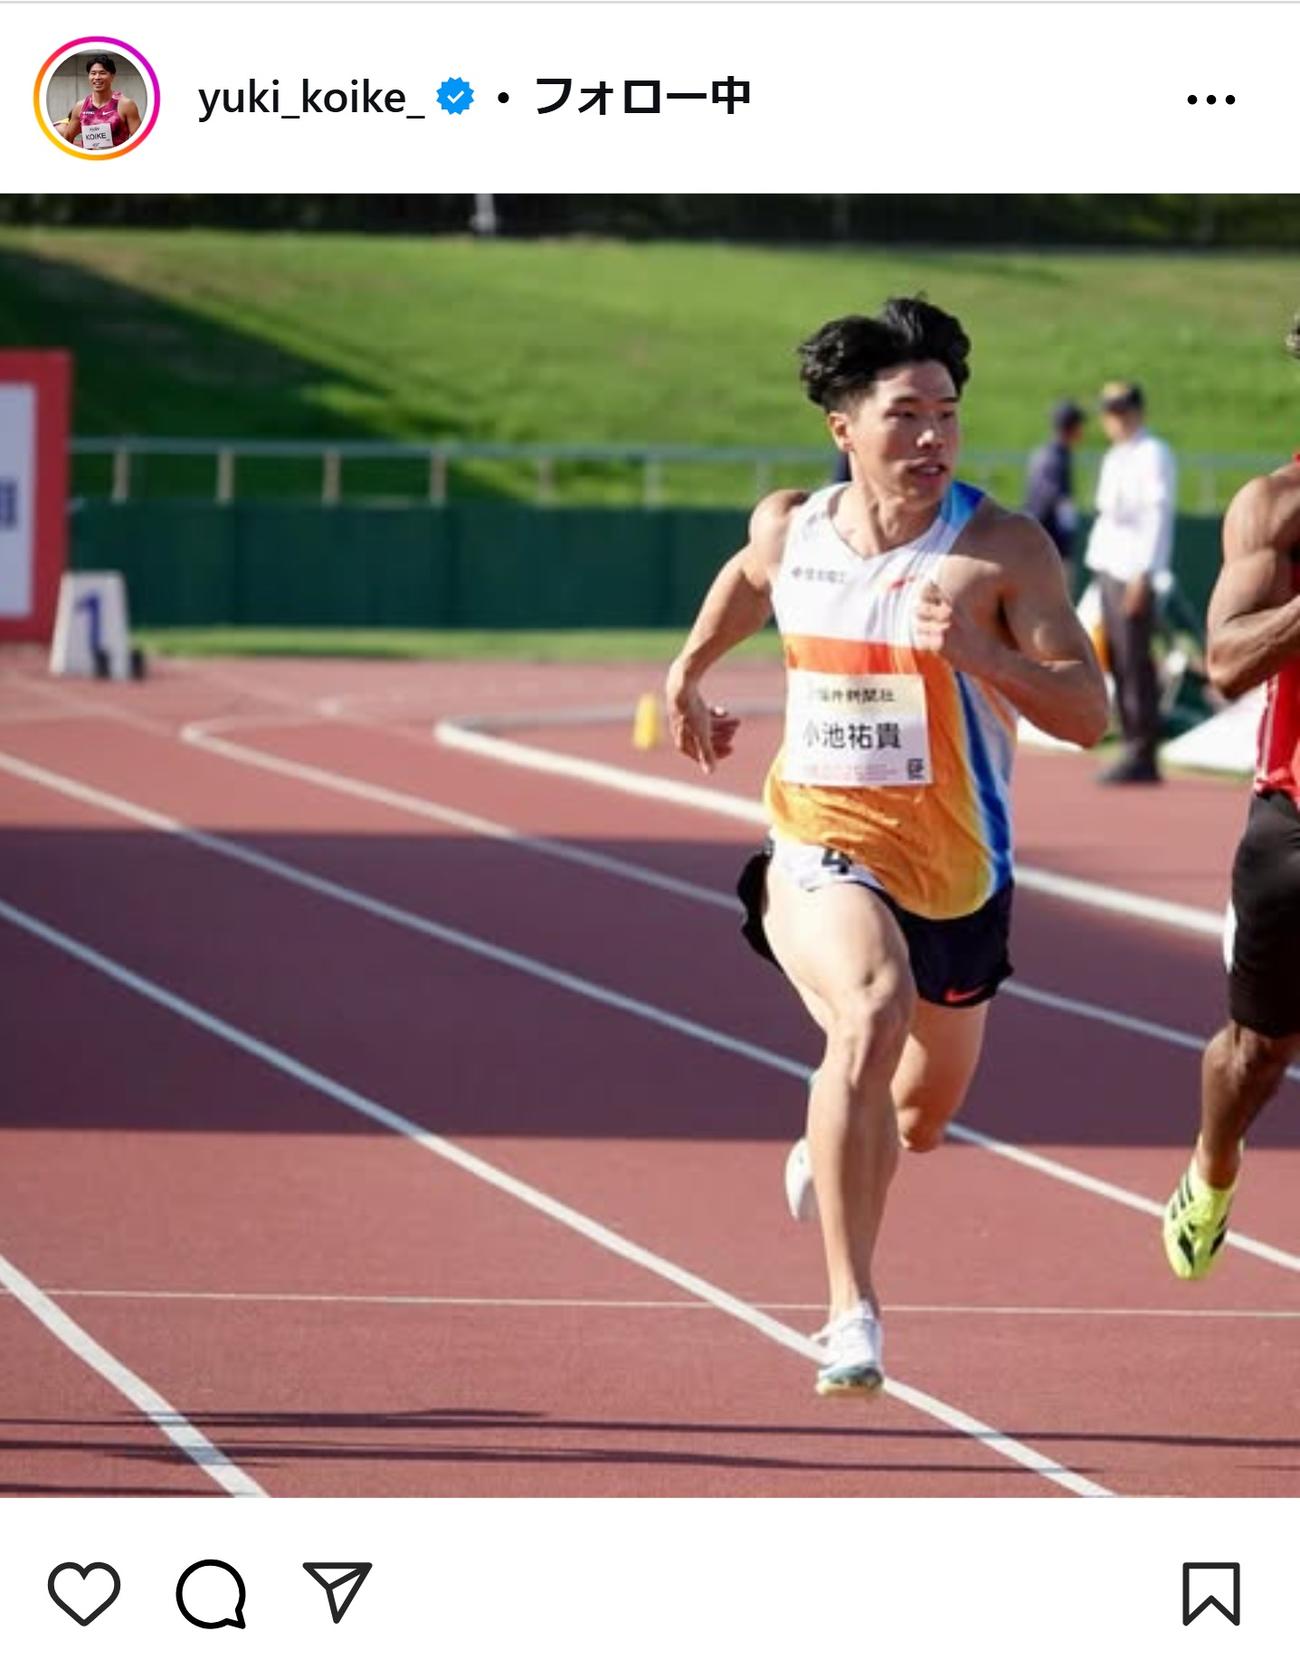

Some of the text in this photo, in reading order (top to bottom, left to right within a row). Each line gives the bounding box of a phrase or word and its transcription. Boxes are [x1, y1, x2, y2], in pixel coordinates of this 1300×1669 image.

[86, 132, 107, 141] KOIKE
[803, 719, 902, 750] 小池祐貴
[821, 847, 853, 875] 4
